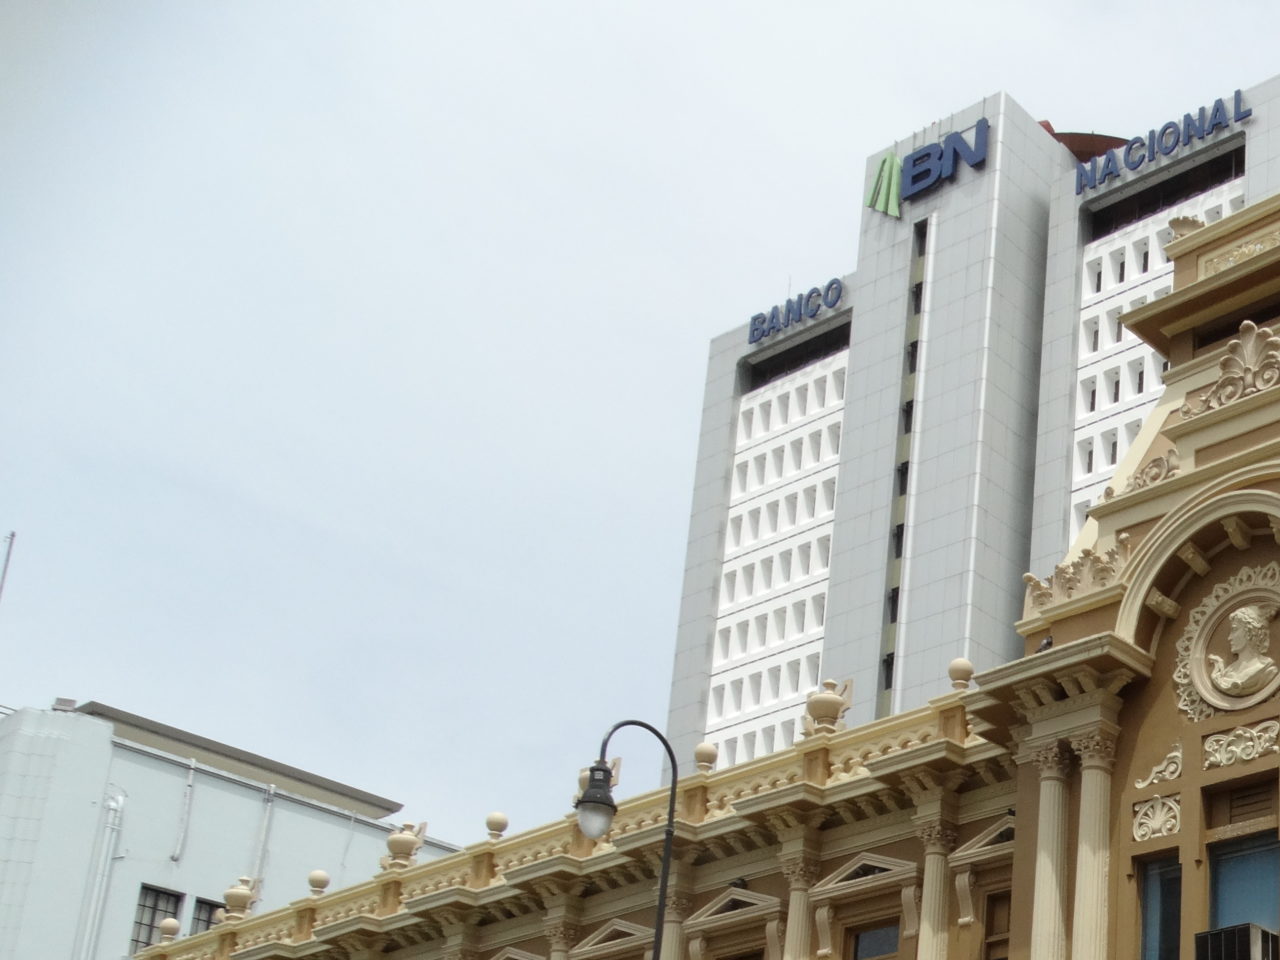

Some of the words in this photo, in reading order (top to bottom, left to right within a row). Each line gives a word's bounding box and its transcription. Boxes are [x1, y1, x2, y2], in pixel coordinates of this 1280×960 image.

[901, 117, 989, 201] BN
[1075, 89, 1252, 195] NACIONAL
[748, 278, 843, 344] BANCO
